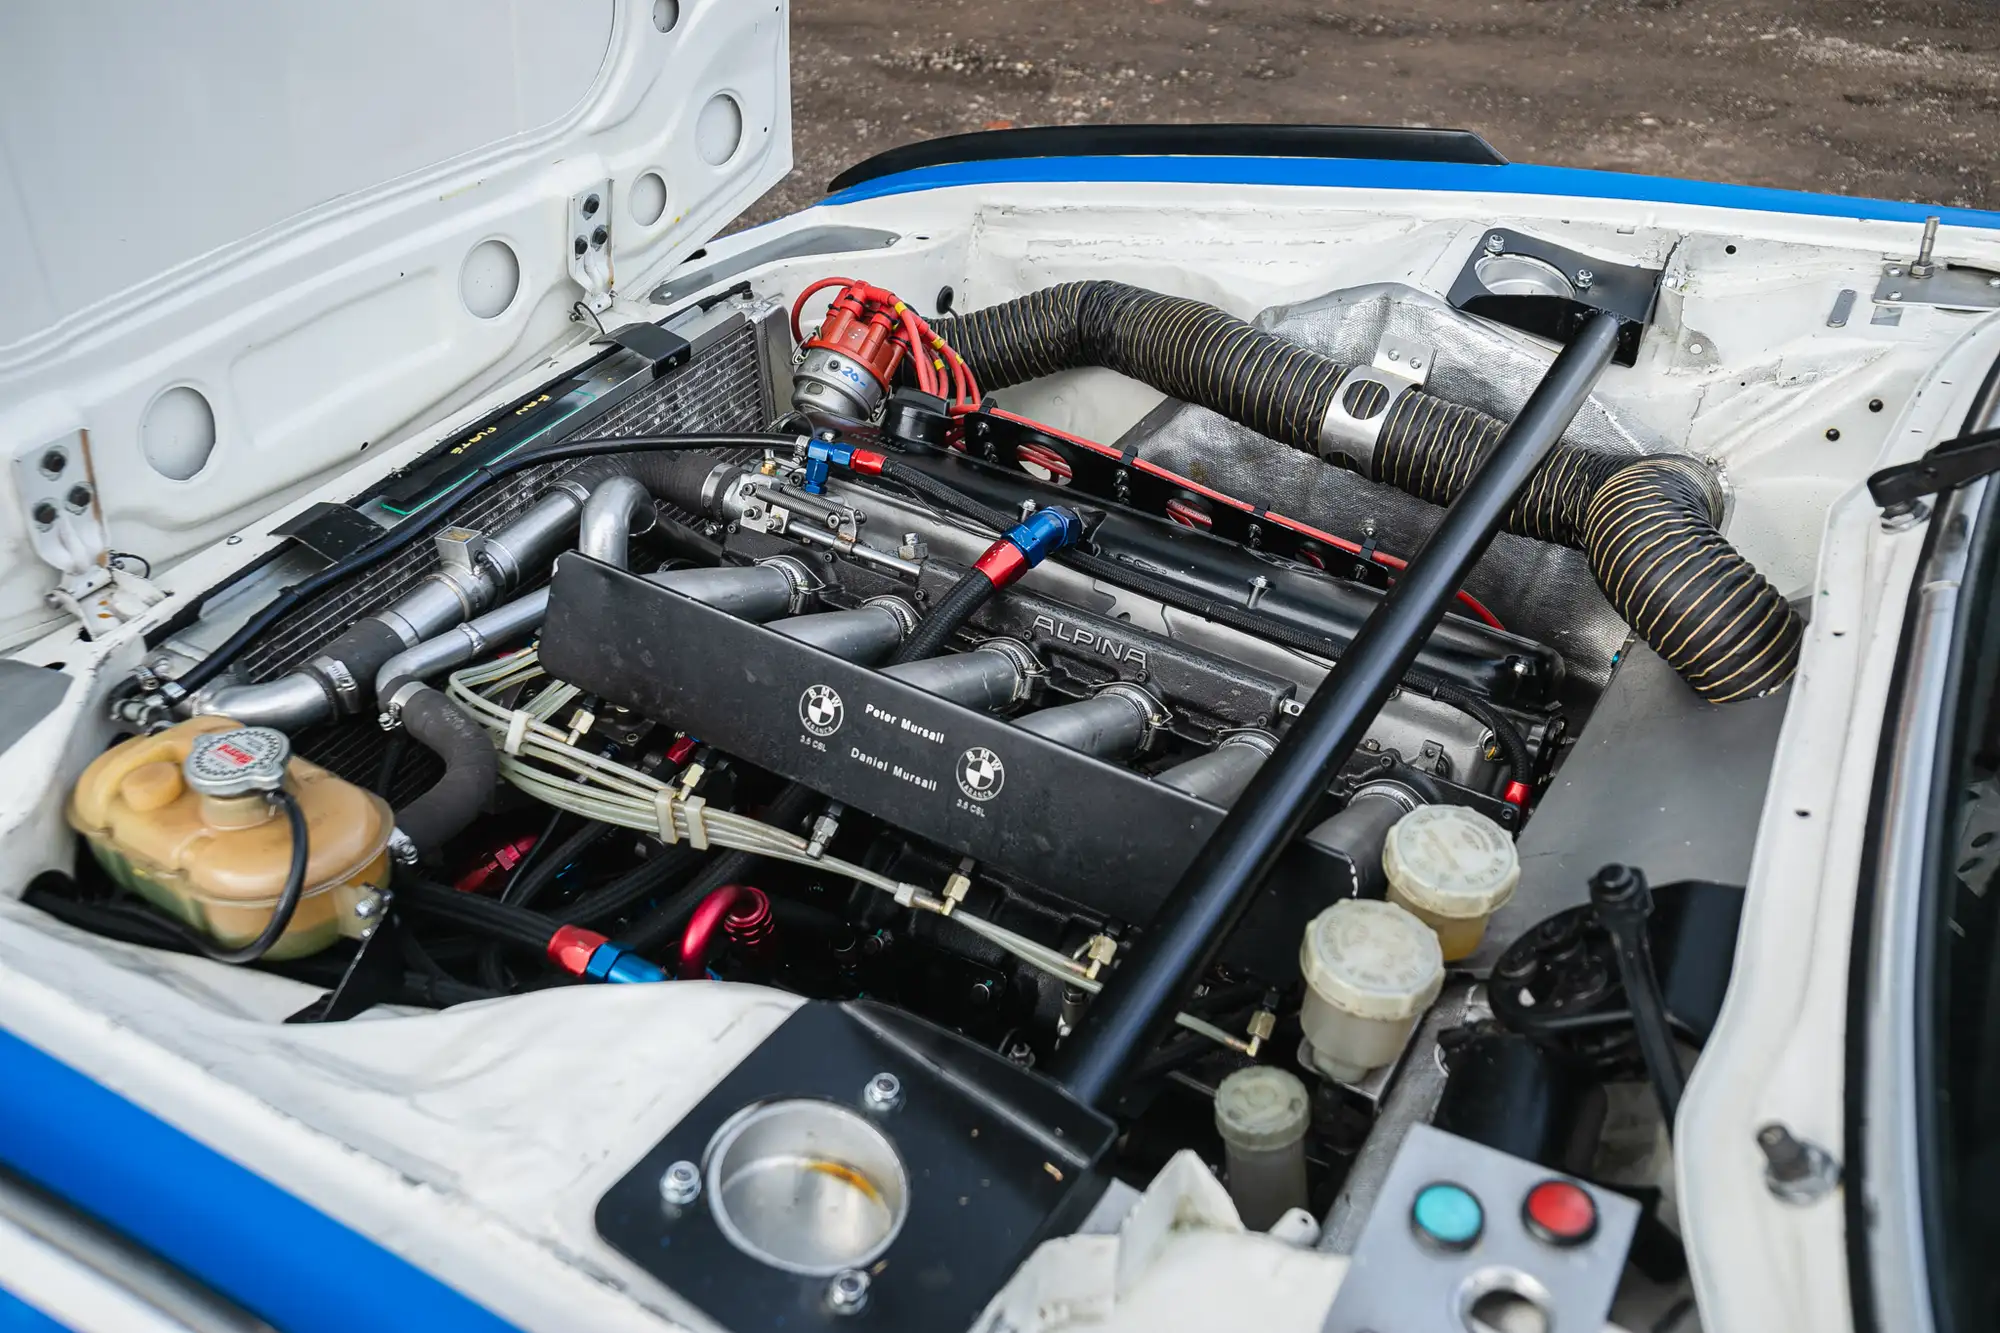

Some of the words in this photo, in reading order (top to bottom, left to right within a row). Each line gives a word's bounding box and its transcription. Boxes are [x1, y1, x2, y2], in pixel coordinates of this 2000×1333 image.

[1032, 615, 1147, 669] ALPINA
[865, 703, 897, 724] Peter
[901, 718, 945, 744] Mursall
[812, 739, 827, 752] CSL
[851, 747, 888, 772] Daniel
[893, 765, 938, 792] Mursall
[969, 804, 986, 818] CSL
